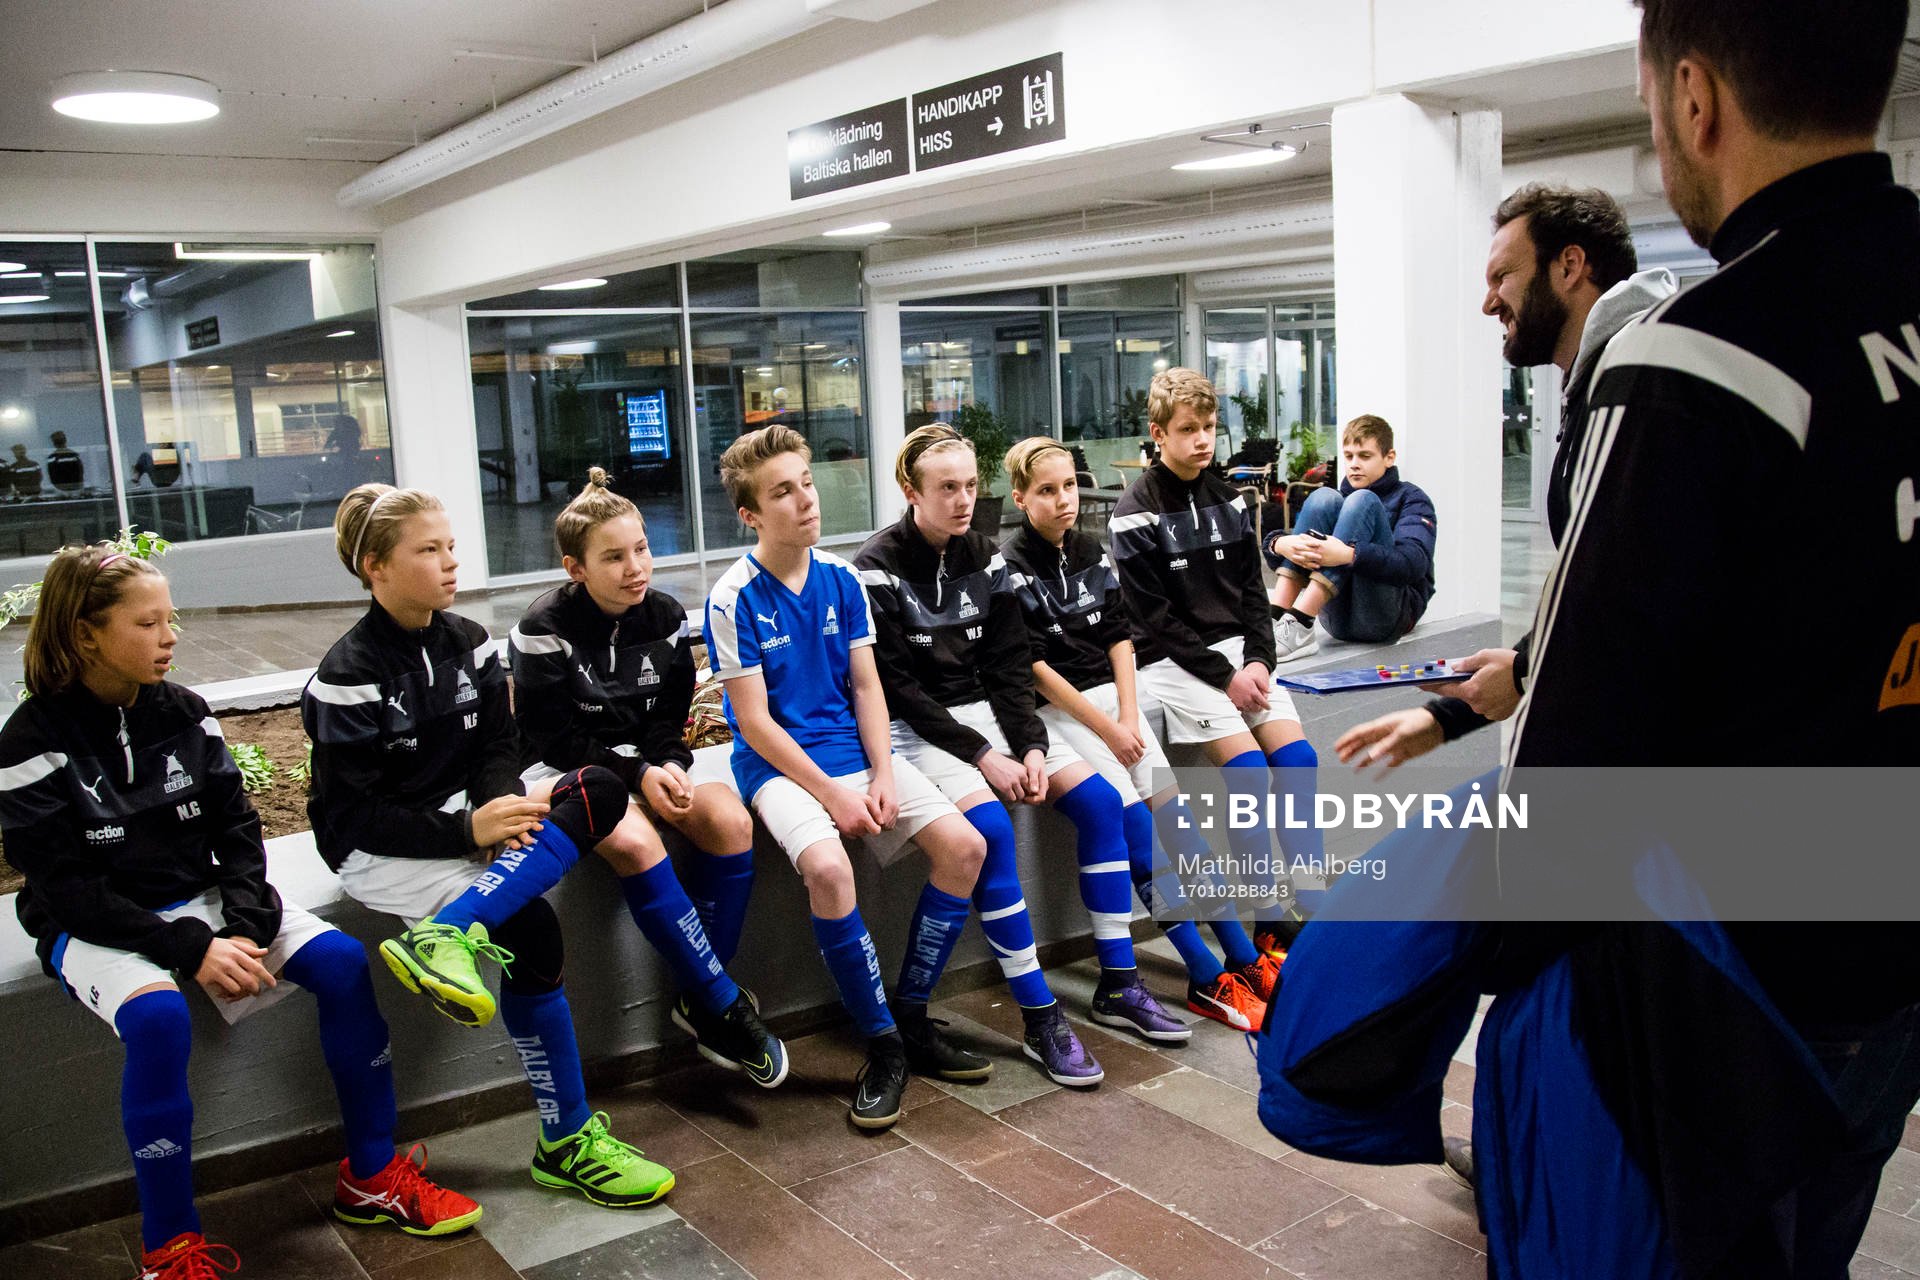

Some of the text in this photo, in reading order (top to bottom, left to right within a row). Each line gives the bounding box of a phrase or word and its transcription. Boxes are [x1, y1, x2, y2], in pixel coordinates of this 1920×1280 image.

[918, 85, 1002, 125] HANDIKAPP
[919, 131, 953, 155] HISS
[803, 148, 892, 183] Baltiska hallen
[760, 634, 792, 651] action
[176, 800, 201, 821] N.G
[85, 825, 125, 841] action
[472, 871, 506, 896] GIF
[512, 1035, 560, 1125] DALBY GIF
[134, 1145, 183, 1159] adidas
